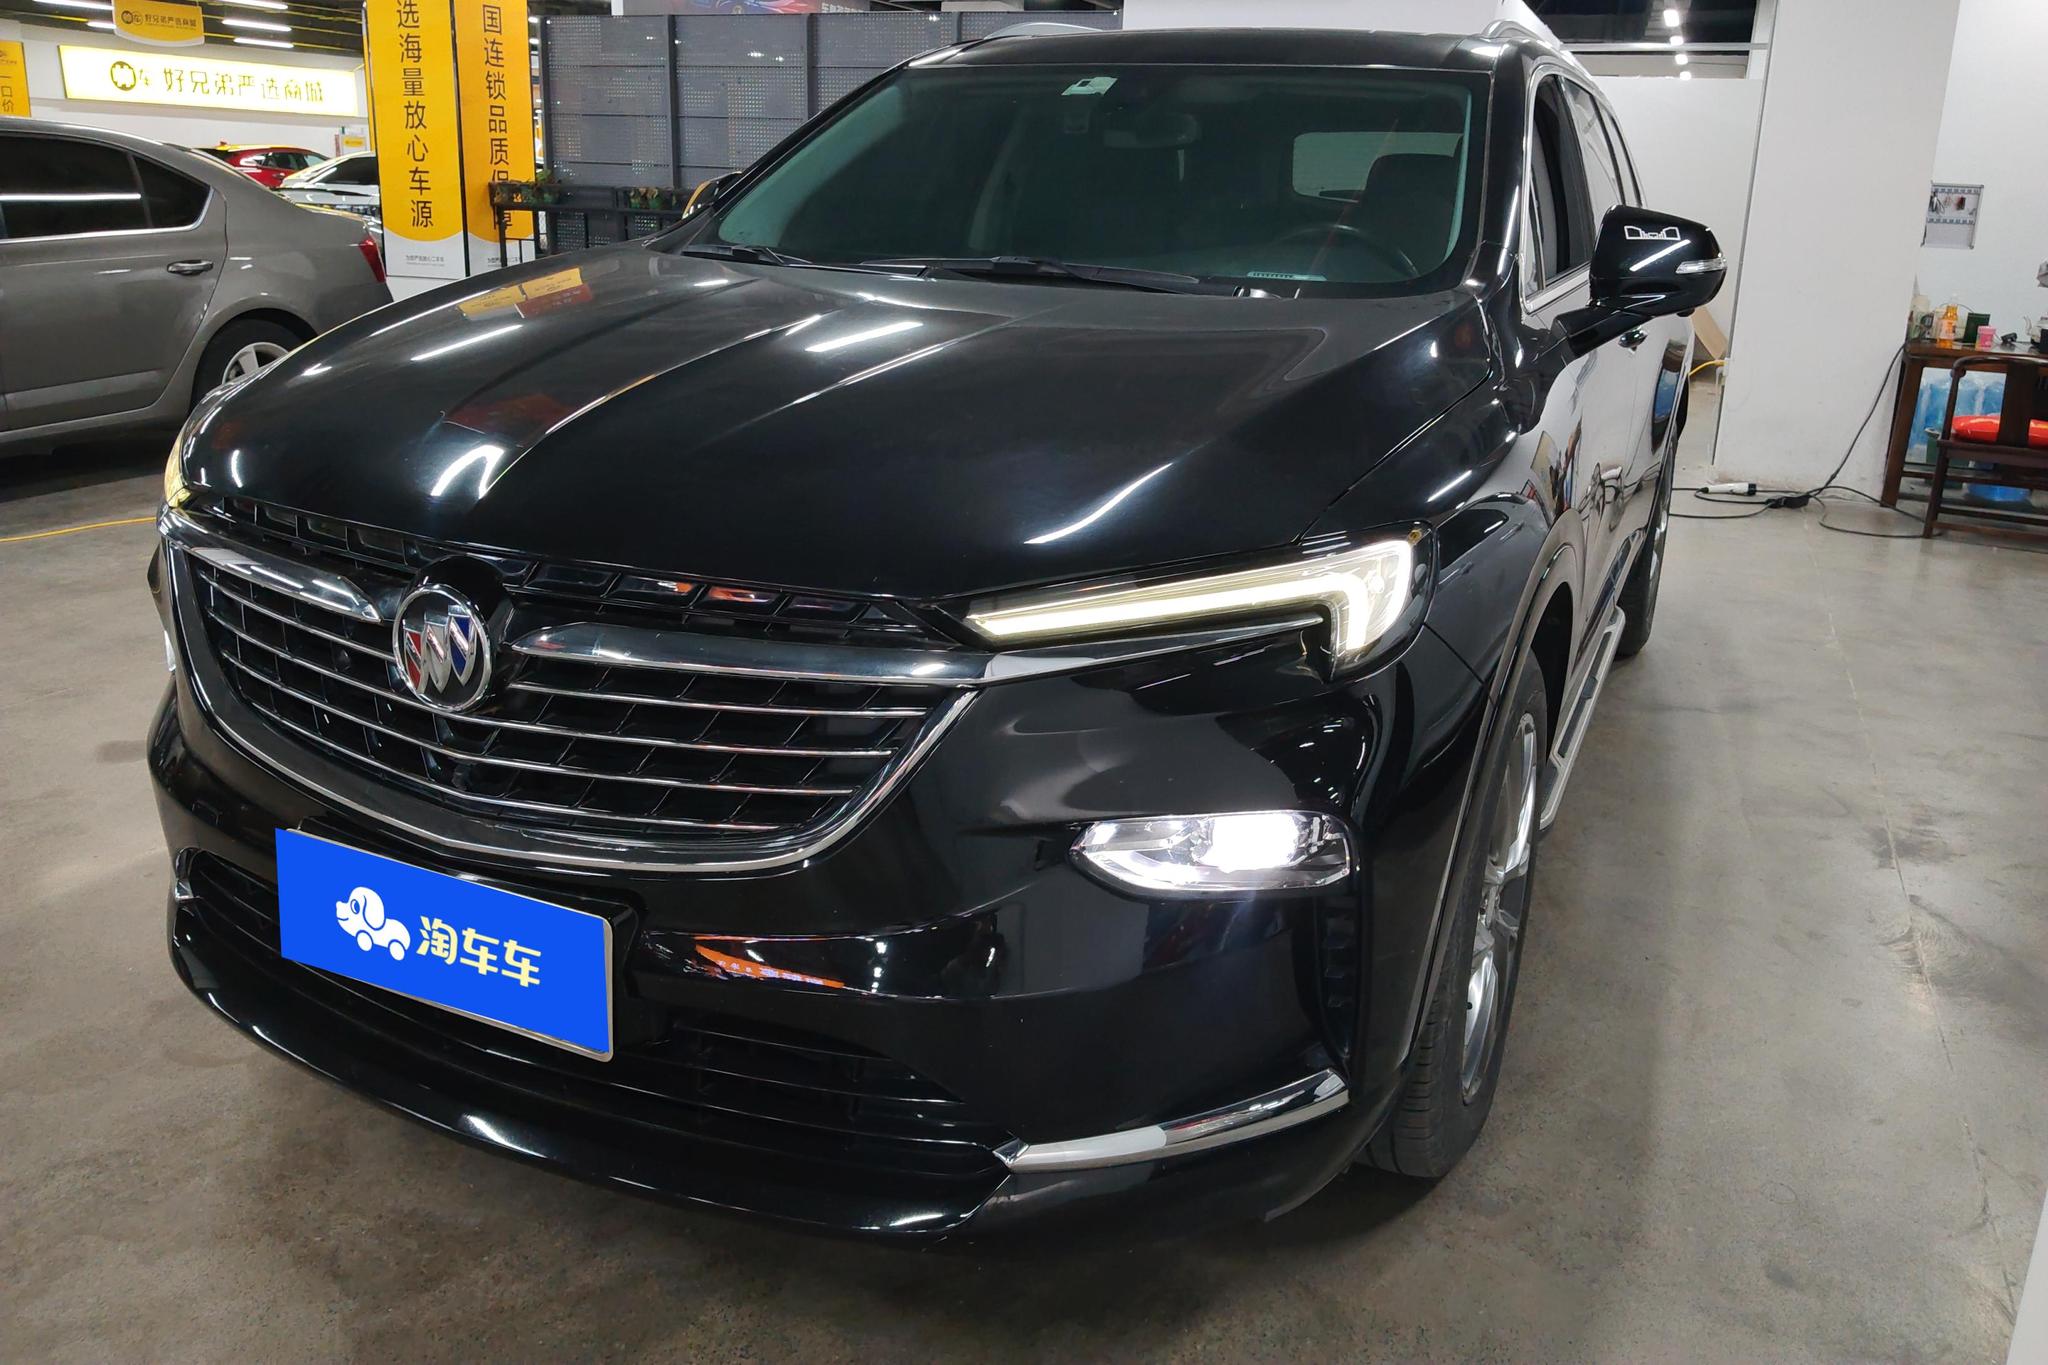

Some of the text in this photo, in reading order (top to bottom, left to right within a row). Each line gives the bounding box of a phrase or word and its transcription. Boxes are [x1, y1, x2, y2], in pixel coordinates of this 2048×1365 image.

[163, 67, 323, 102] 好兄弟严选商城
[396, 0, 434, 228] 选海量放心车源
